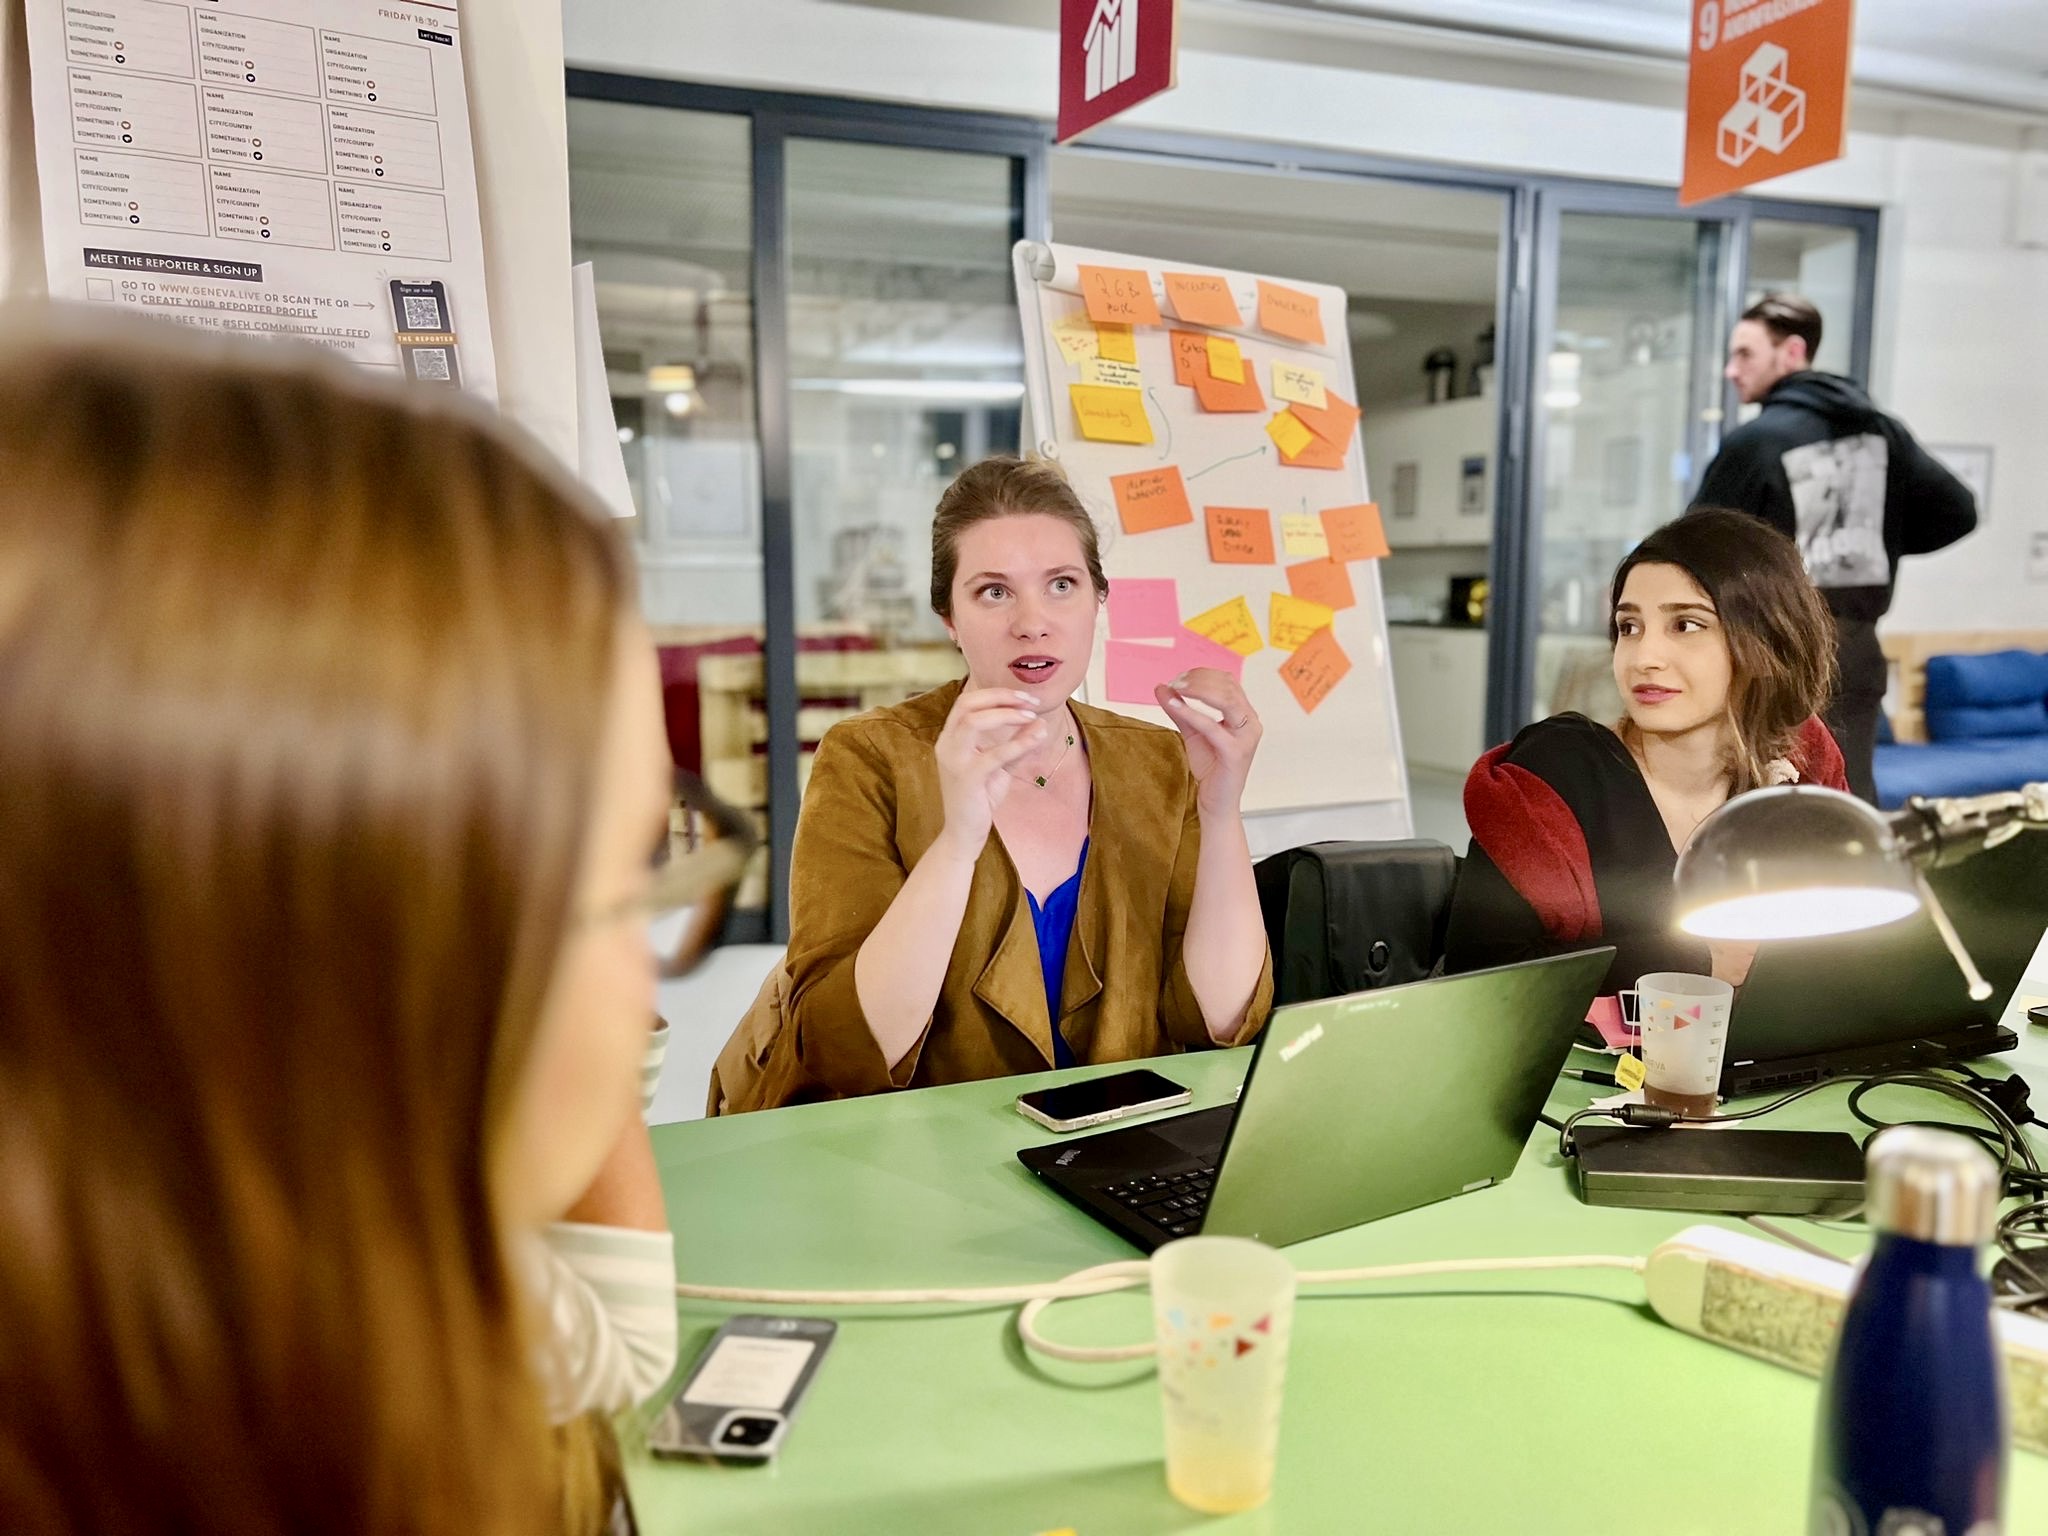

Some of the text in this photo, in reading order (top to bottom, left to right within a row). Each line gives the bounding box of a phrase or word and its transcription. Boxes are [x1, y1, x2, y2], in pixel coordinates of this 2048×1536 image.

[67, 7, 116, 19] ORGANIZATION
[378, 9, 438, 28] FRIDAY 18:30
[1698, 1, 1720, 51] 9
[201, 28, 246, 39] ORGANIZATION
[202, 41, 245, 52] CITY/COUNTRY
[325, 48, 368, 60] ORGANIZATION
[203, 55, 239, 65] SOMETHING
[327, 62, 367, 72] CITY/COUNTRY
[204, 69, 240, 79] SOMETHING
[328, 75, 361, 85] SOMETHING
[74, 88, 122, 99] ORGANIZATION
[329, 88, 363, 98] SOMETHING
[208, 106, 253, 117] ORGANIZATION
[76, 116, 114, 126] SOMETHING
[209, 120, 252, 130] CITY/COUNTRY
[333, 124, 375, 135] ORGANIZATION
[77, 131, 116, 140] SOMETHING
[210, 134, 246, 143] SOMETHING
[334, 138, 374, 147] CITY/COUNTRY
[212, 147, 247, 157] SOMETHING
[335, 151, 368, 160] SOMETHING
[81, 169, 130, 179] ORGANIZATION
[336, 164, 370, 174] SOMETHING
[82, 184, 128, 193] CITY/COUNTRY
[215, 185, 260, 195] ORGANIZATION
[83, 198, 122, 207] SOMETHING
[217, 198, 260, 208] CITY/COUNTRY
[340, 201, 382, 210] ORGANIZATION
[84, 212, 123, 221] SOMETHING
[218, 212, 254, 221] SOMETHING
[341, 214, 381, 223] CITY/COUNTRY
[219, 226, 255, 235] SOMETHING
[342, 227, 375, 235] SOMETHING
[344, 240, 377, 248] SOMETHING
[90, 254, 258, 276] MEET THE REPORTER & SIGN UP
[121, 280, 138, 290] GO
[142, 282, 156, 291] TO
[160, 283, 260, 300] WWW.GENEVA.LIVE
[265, 293, 279, 302] OR
[282, 295, 310, 305] SCAN
[314, 297, 332, 306] THE
[122, 293, 318, 319] TO CREATE YOUR REPORTER PROFILE
[158, 313, 172, 321] TO
[176, 315, 196, 324] SEE
[199, 317, 218, 326] THE
[222, 319, 250, 329] #SFH
[254, 322, 318, 334] COMMUNITY
[321, 327, 342, 336] LIVE
[346, 329, 370, 338] FEED
